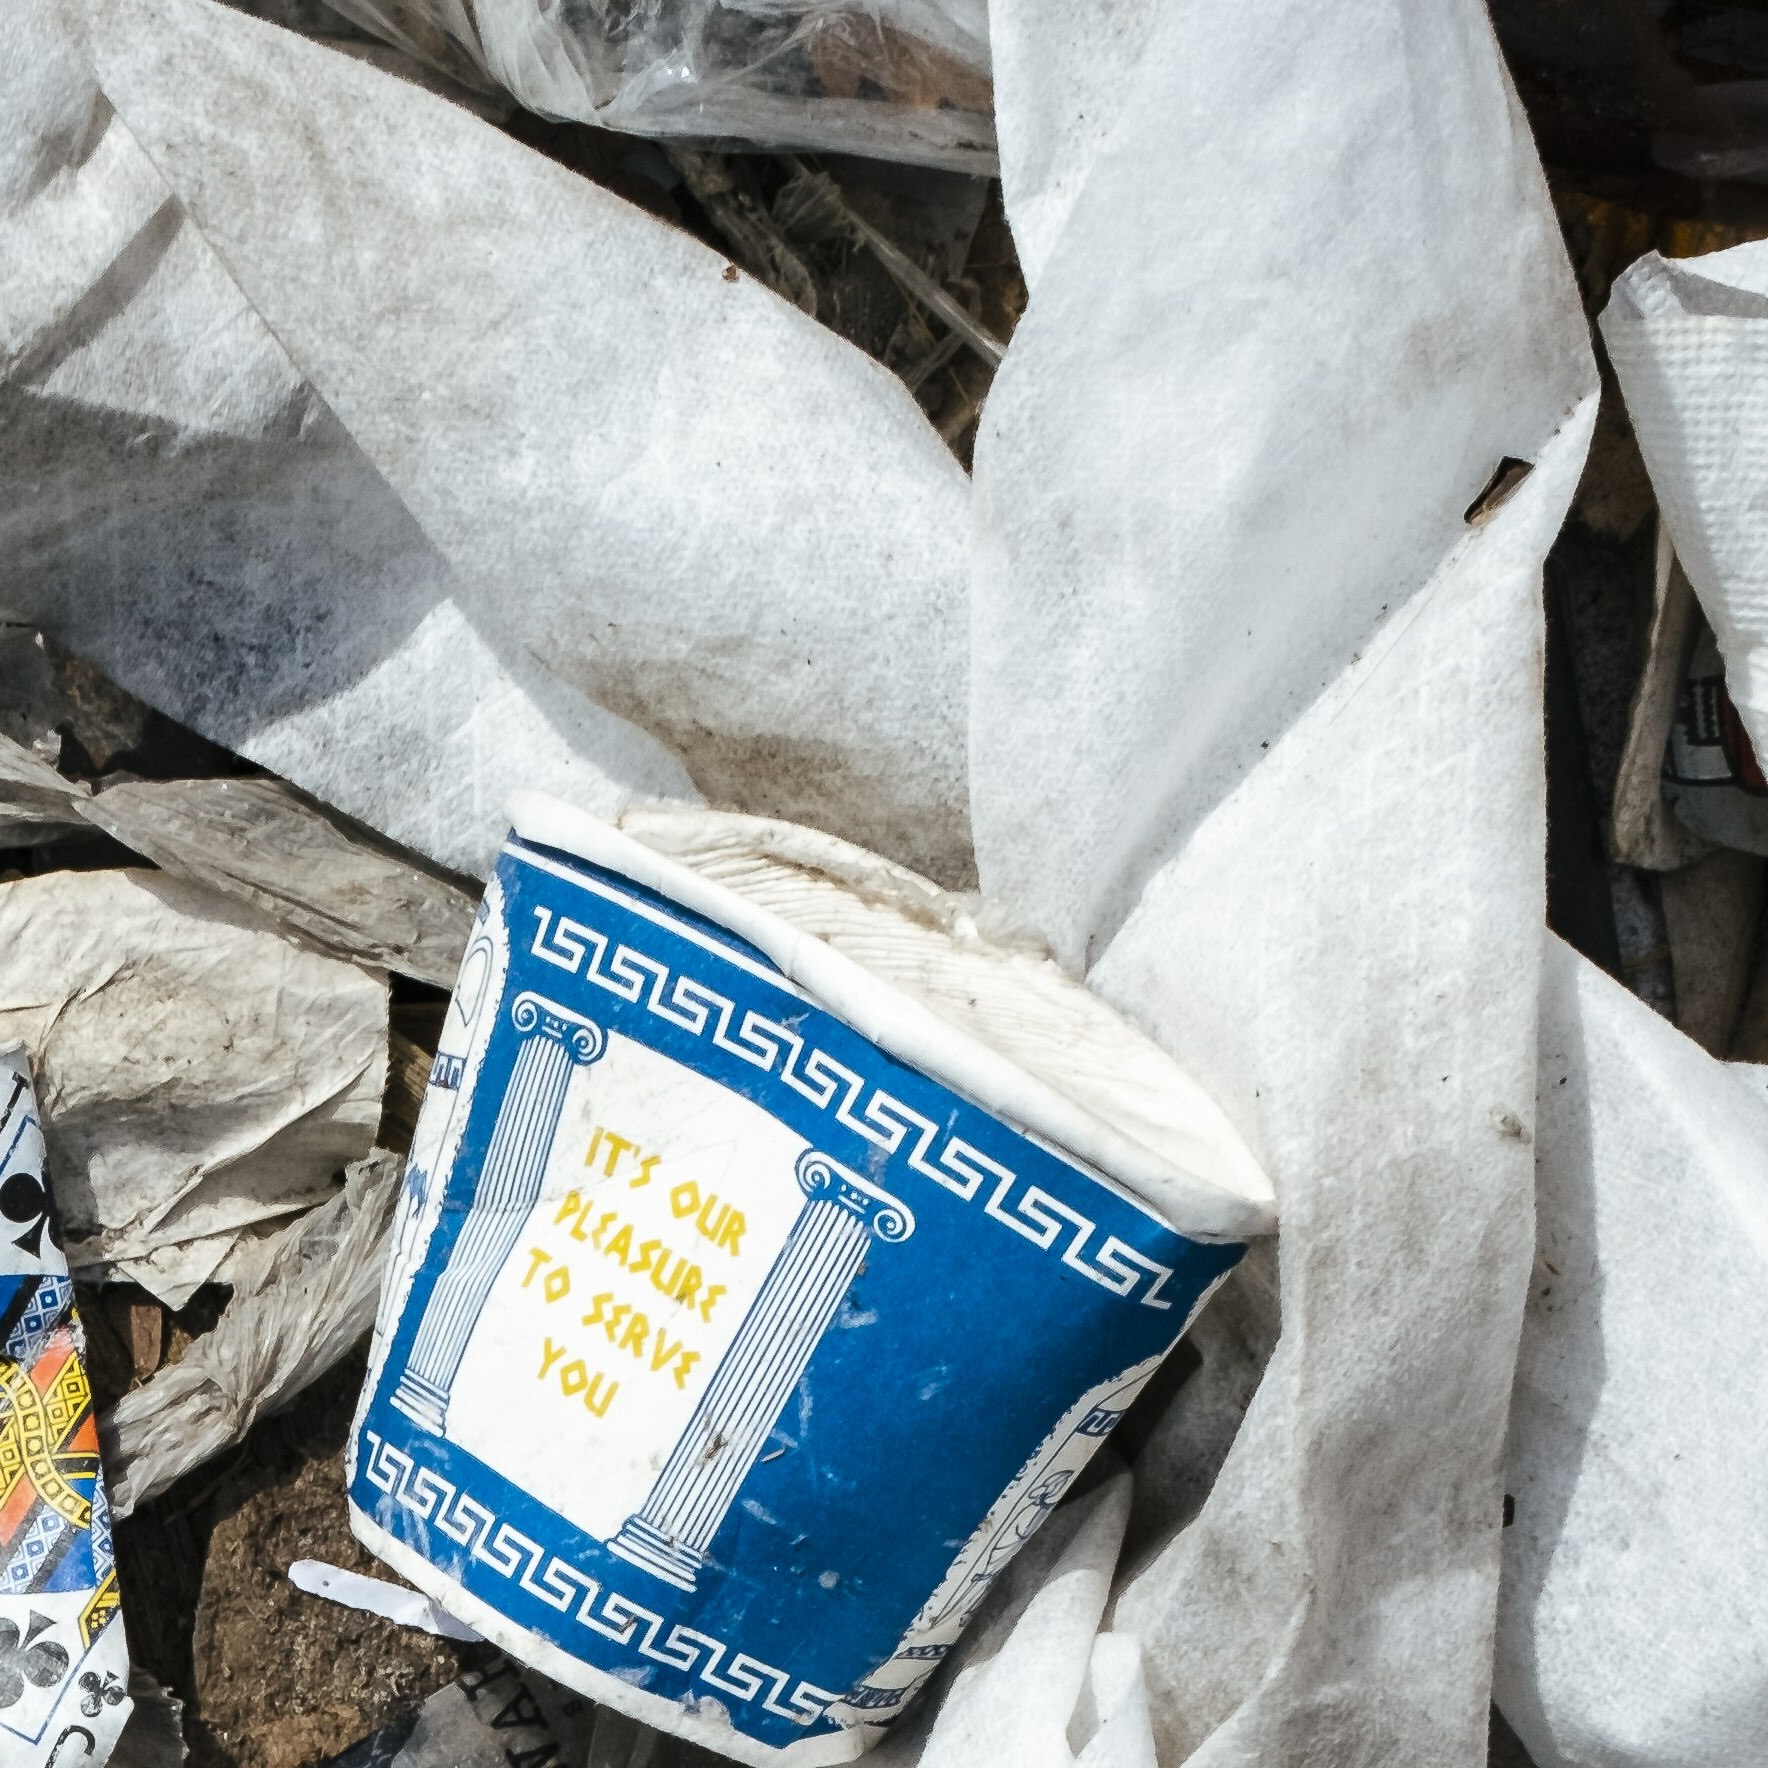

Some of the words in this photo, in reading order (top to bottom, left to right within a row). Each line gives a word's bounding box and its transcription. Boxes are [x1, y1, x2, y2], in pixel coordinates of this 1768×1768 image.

[552, 1190, 728, 1325] PLEASURE
[584, 1126, 654, 1193] IT'S
[669, 1181, 749, 1257] OUR
[518, 1247, 570, 1303] TO
[580, 1288, 702, 1391] SERVE
[537, 1337, 621, 1419] YOU
